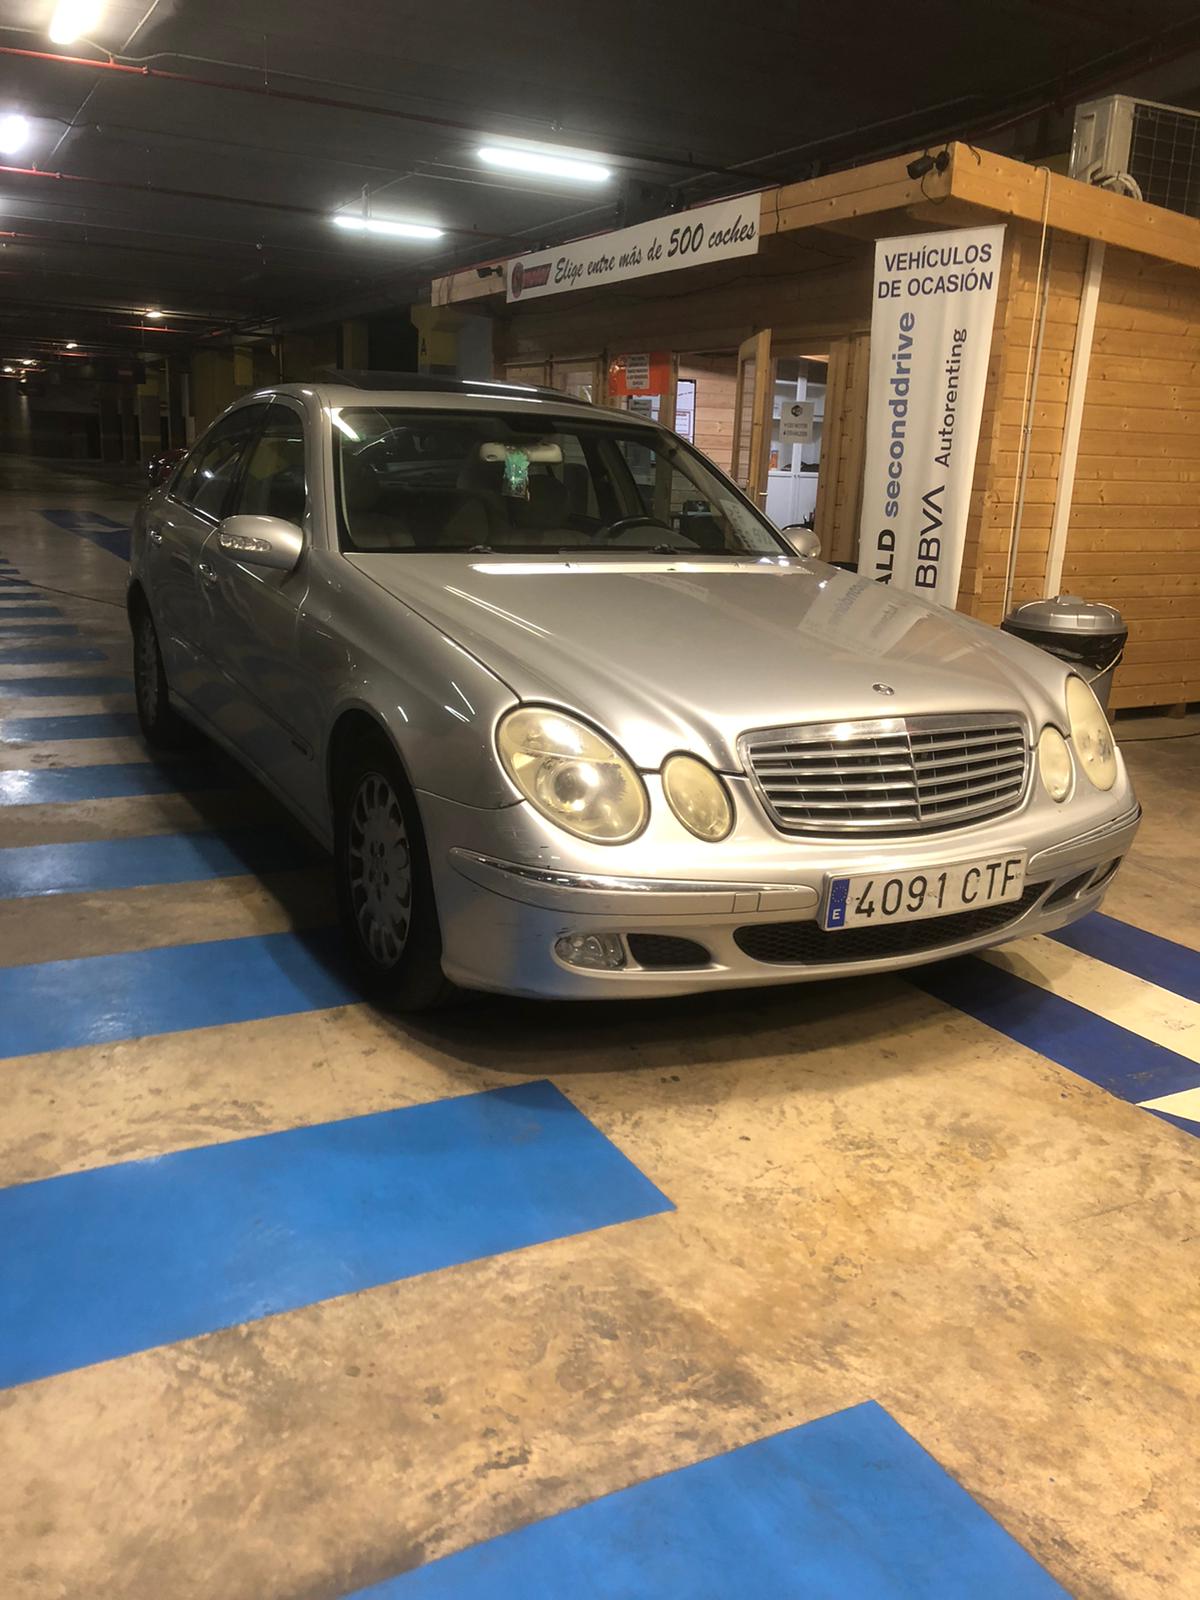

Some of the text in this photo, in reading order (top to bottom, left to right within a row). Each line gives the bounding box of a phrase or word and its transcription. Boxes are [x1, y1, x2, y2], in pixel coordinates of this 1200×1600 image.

[554, 257, 583, 286] Elige
[587, 257, 616, 276] entre
[618, 246, 643, 267] más
[647, 238, 663, 259] de
[667, 223, 704, 258] 500
[708, 214, 756, 249] coches
[884, 243, 992, 272] VEHÍCULOS
[878, 268, 994, 299] DE OCASIÓN
[885, 312, 915, 518] seconddrive
[915, 329, 967, 588] BBVA Autorenting
[875, 529, 896, 585] ALD
[832, 908, 841, 920] E
[855, 859, 1022, 918] 4091 CTF
